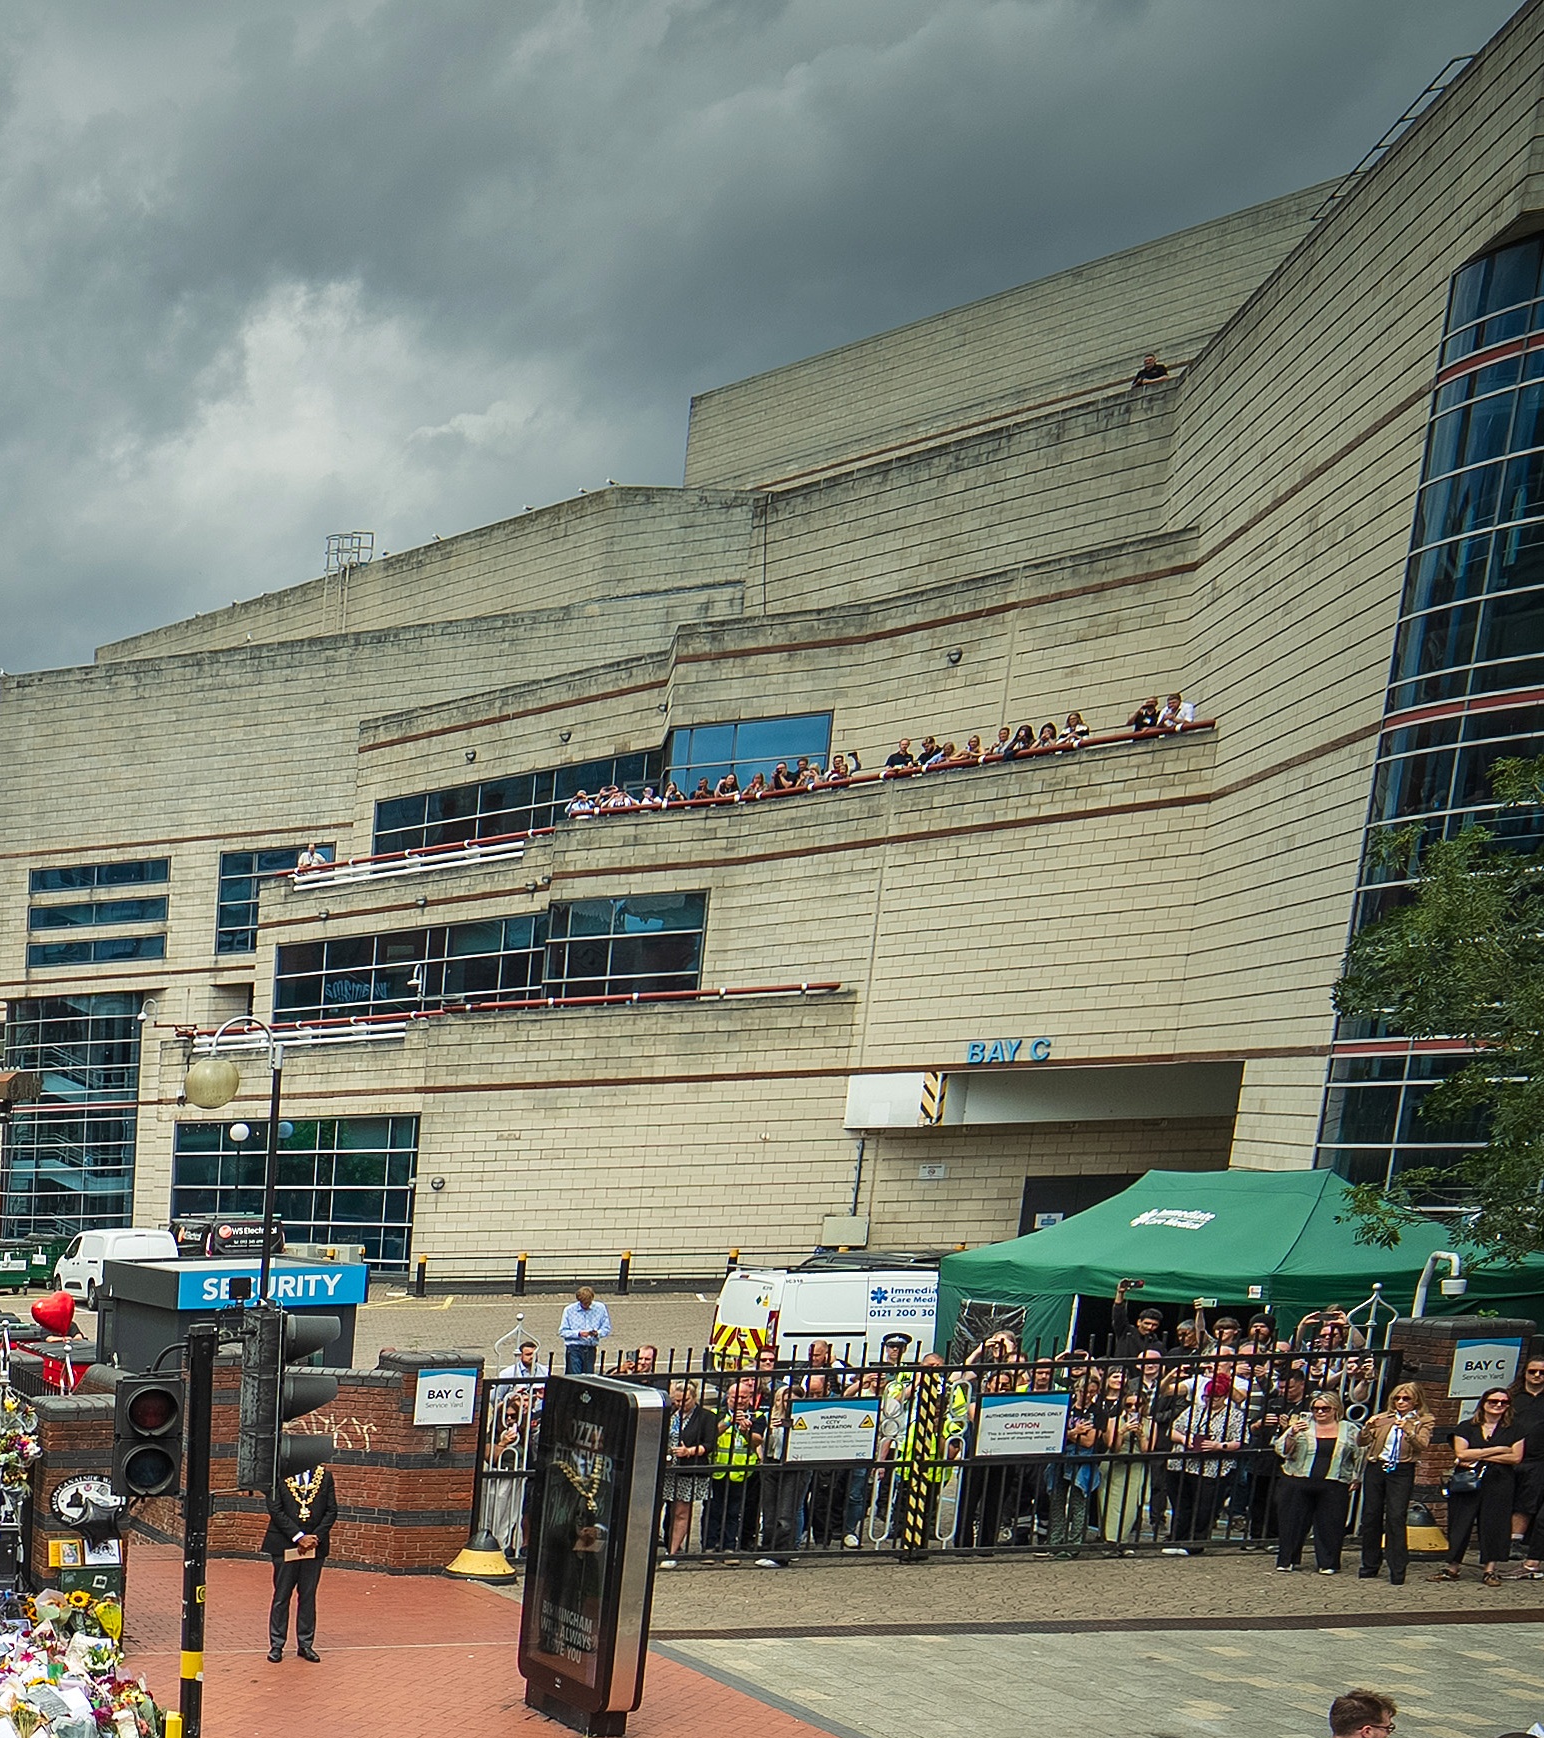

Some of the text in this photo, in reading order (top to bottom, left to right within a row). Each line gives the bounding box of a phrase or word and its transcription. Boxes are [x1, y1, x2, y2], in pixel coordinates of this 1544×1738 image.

[967, 1038, 1050, 1064] BAY C
[890, 1286, 935, 1295] Immedia
[890, 1295, 935, 1304] Care Medi
[869, 1309, 934, 1318] 0121 200 30
[1464, 1360, 1506, 1372] BAY C
[427, 1389, 464, 1400] BAY C
[1004, 1422, 1040, 1430] CAUTION
